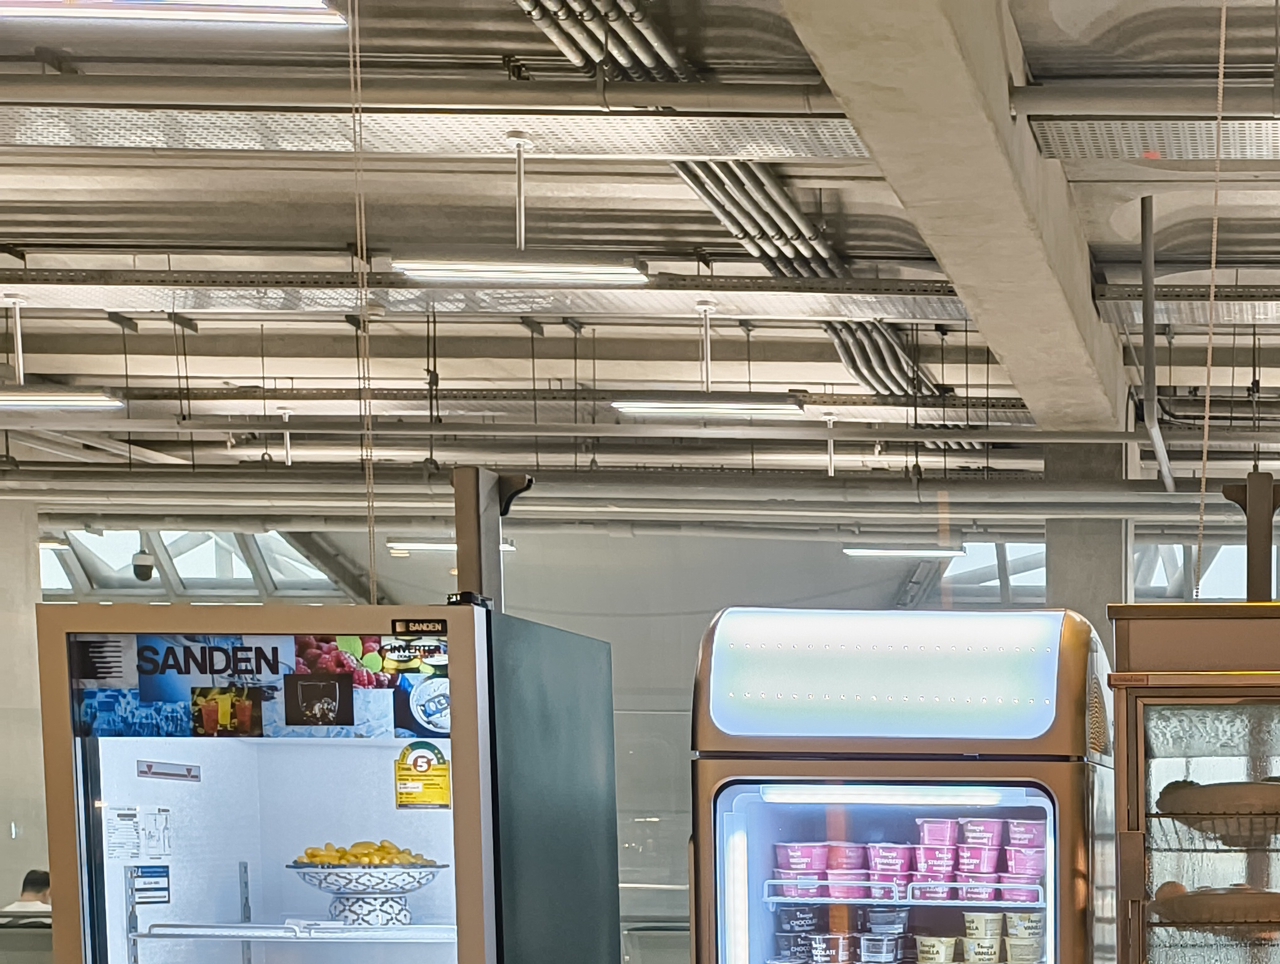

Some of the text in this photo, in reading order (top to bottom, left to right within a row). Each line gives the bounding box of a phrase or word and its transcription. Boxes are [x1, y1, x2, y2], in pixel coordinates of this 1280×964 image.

[409, 623, 442, 631] SANDEN
[390, 645, 442, 655] INVERTER
[136, 645, 279, 675] SANDEN
[416, 757, 429, 772] 5
